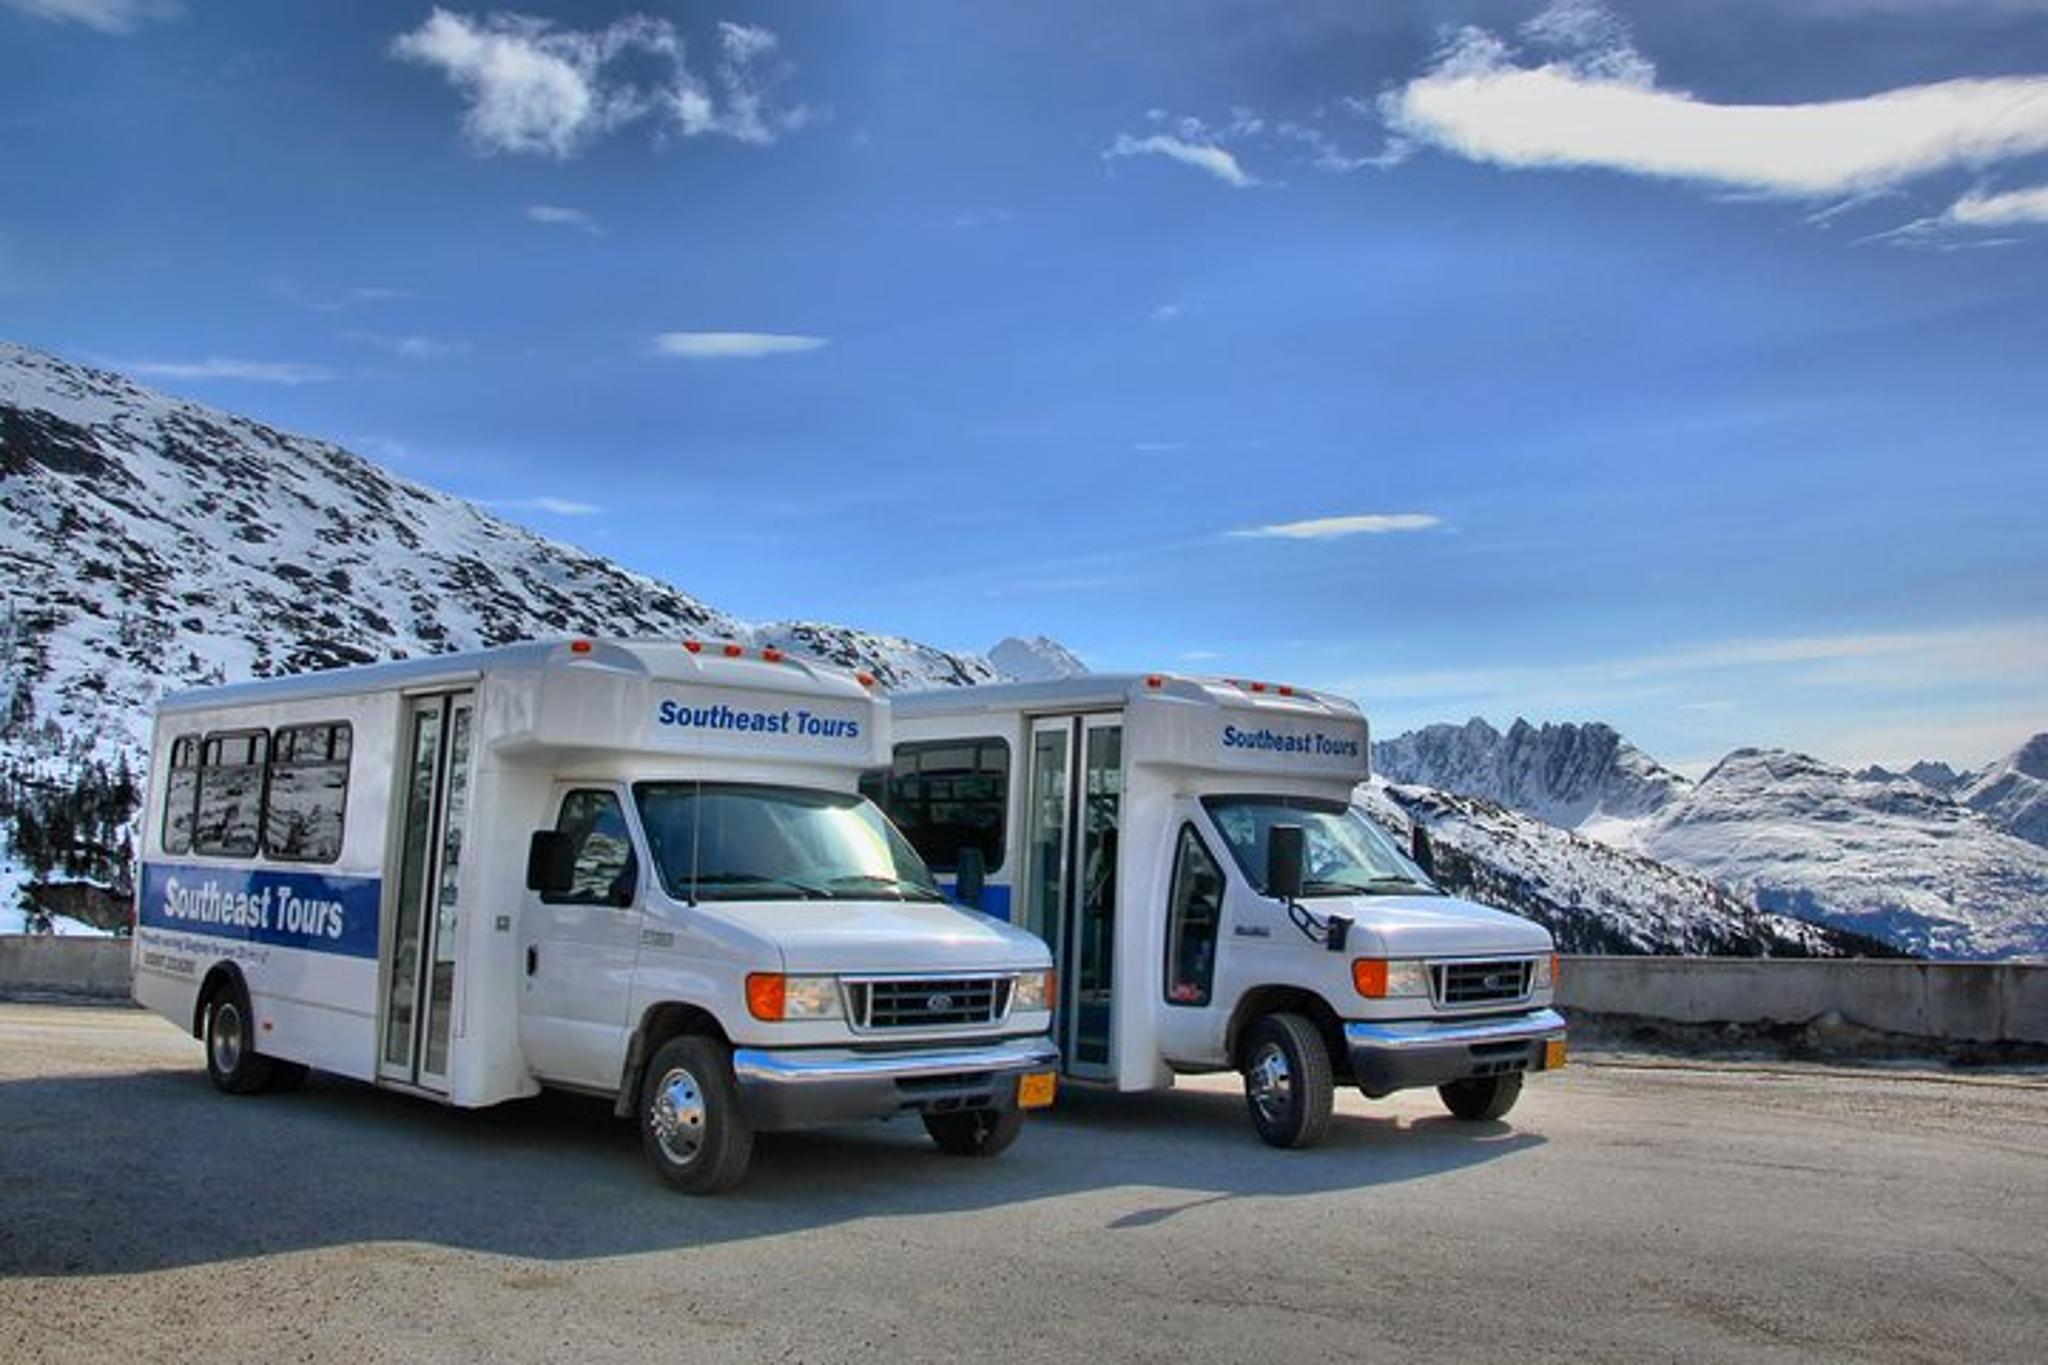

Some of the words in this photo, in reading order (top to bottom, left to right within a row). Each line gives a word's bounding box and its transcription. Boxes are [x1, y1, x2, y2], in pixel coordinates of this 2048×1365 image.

[659, 701, 788, 733] Southeast
[798, 711, 858, 737] Tours
[1223, 725, 1310, 753] Southeast
[1316, 734, 1357, 756] Tours
[164, 877, 270, 927] Southeast
[278, 887, 343, 938] Tours
